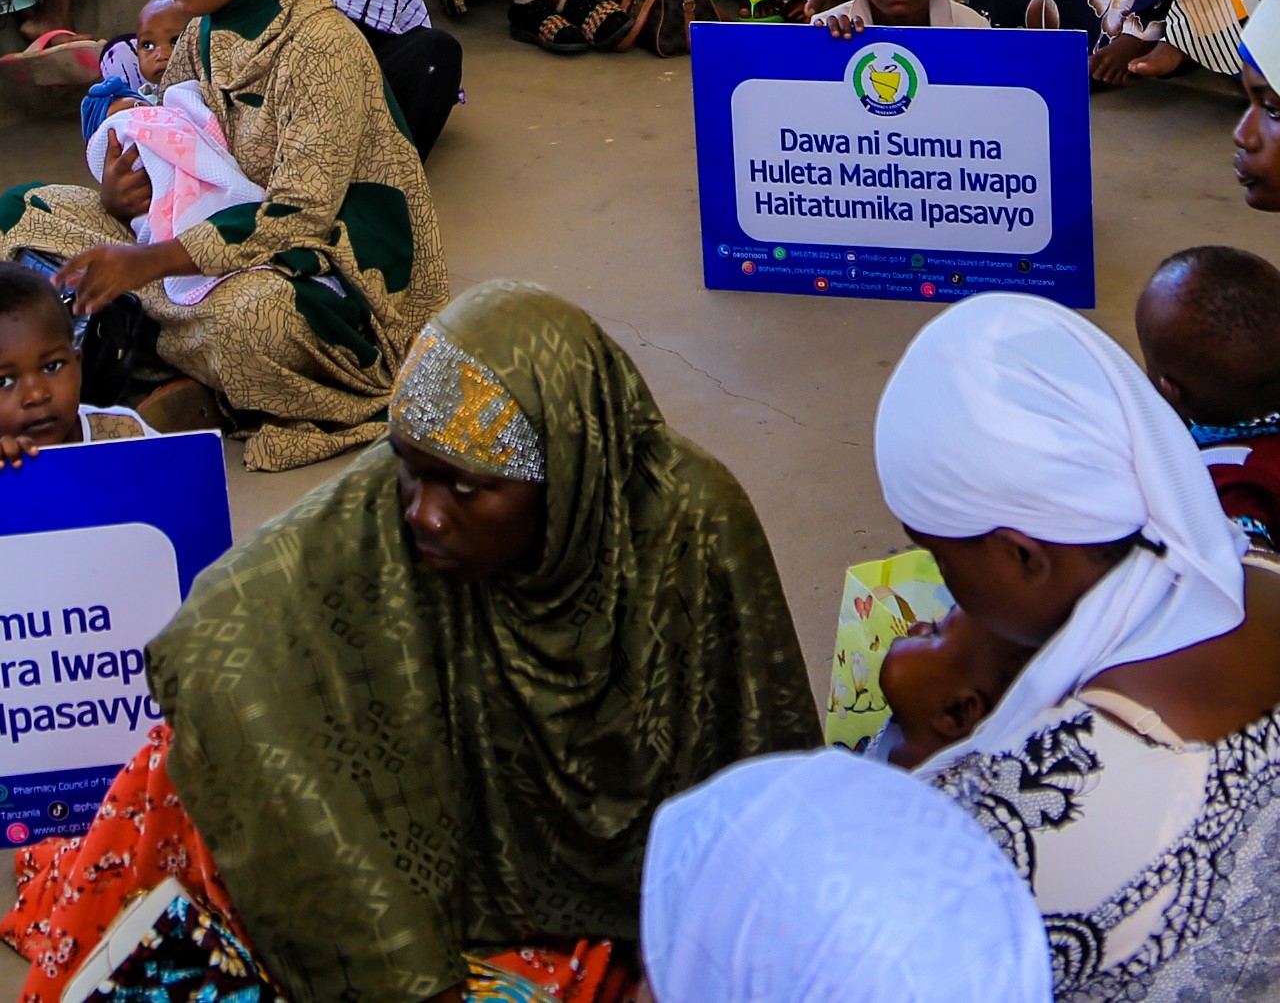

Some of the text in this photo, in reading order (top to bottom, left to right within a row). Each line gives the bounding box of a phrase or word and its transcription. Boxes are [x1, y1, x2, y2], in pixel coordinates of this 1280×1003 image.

[780, 128, 1002, 160] Dawa ni Sumu na
[750, 159, 1037, 200] Huleta Madhara Iwapo
[755, 191, 1034, 232] Haitatumika Ipasavyo
[63, 604, 111, 635] na
[51, 646, 144, 686] Iwap
[13, 783, 56, 796] Pharmacy
[59, 779, 89, 791] Council
[91, 778, 99, 787] of
[1, 808, 41, 821] Tanzania
